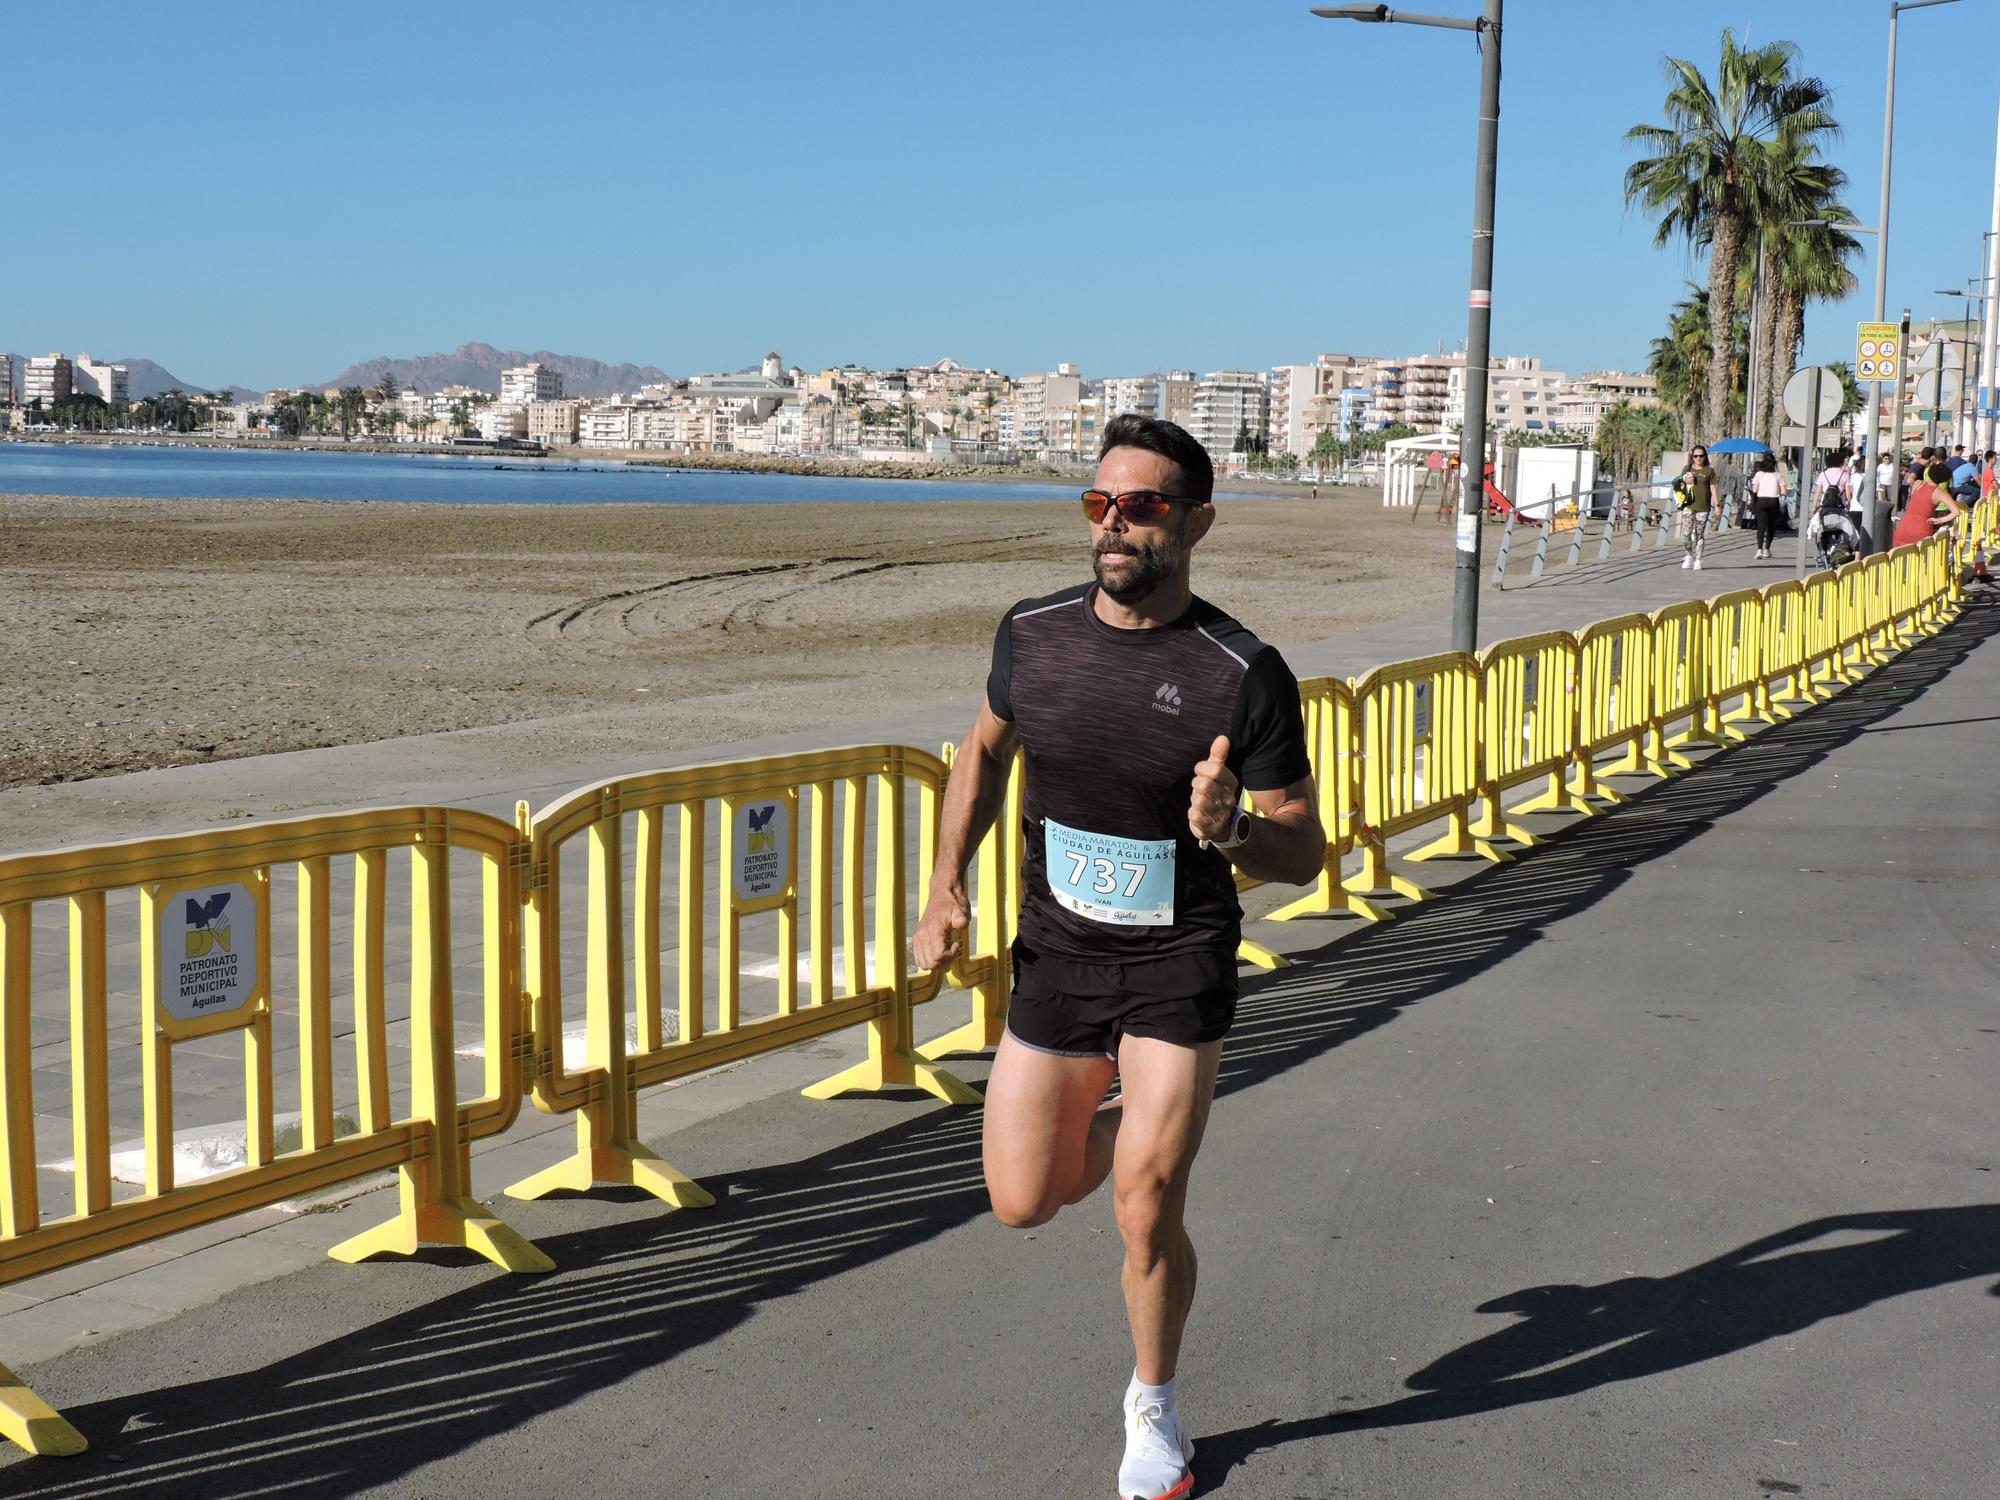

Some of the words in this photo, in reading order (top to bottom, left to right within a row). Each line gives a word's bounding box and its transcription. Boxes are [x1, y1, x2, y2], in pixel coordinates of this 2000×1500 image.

[1152, 703, 1180, 715] mobel
[1052, 834, 1092, 852] CIUDAD
[1097, 847, 1111, 855] DE
[1117, 848, 1169, 859] ÁGUILAS
[1059, 829, 1087, 842] MEDIA
[1089, 836, 1137, 851] MARATÓN
[744, 852, 778, 865] PATRONATO
[744, 861, 778, 874] DEPORTIVO
[1065, 849, 1147, 898] 737
[744, 871, 778, 883] MUNICIPAL
[1094, 898, 1112, 906] IVAN
[180, 953, 238, 973] PATRONATO
[180, 965, 238, 985] DEPORTIVO
[180, 977, 238, 997] MUNICIPAL
[192, 994, 226, 1009] Águilas
